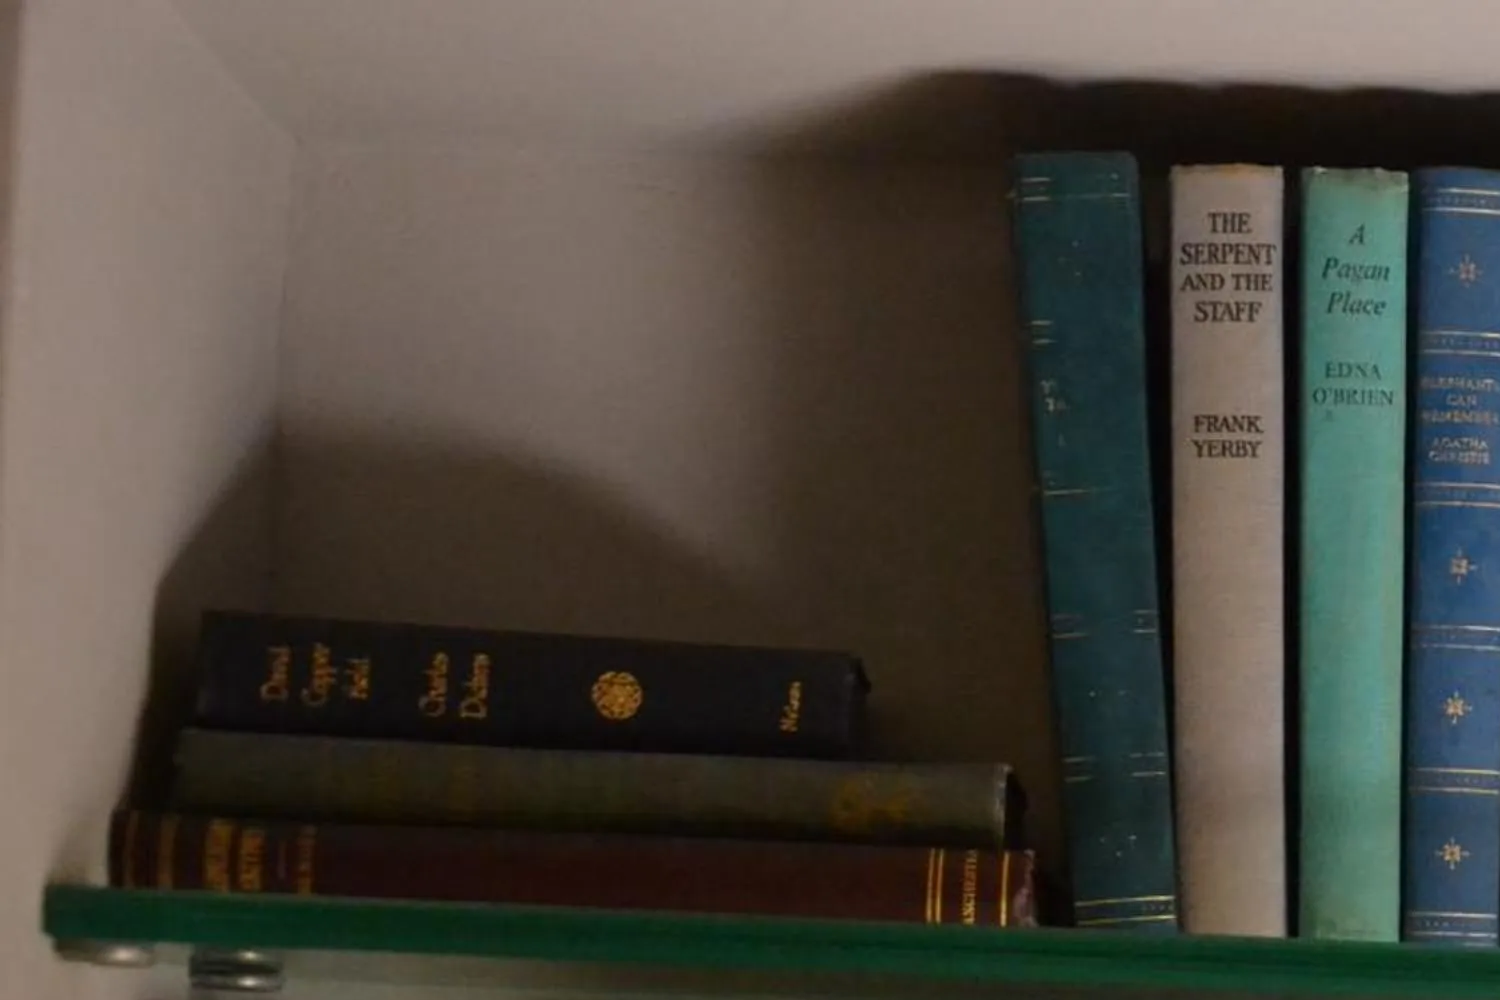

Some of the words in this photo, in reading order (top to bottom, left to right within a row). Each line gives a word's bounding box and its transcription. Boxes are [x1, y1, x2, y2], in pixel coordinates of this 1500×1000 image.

[1208, 212, 1252, 233] THE
[1348, 223, 1366, 246] A
[1179, 242, 1277, 266] SERPENT
[1322, 256, 1391, 283] Pagan
[1180, 273, 1225, 291] AND
[1231, 273, 1273, 291] THE
[1193, 301, 1263, 323] STAFF
[1326, 290, 1387, 316] Place
[1325, 361, 1381, 380] EDNA
[1312, 387, 1394, 406] O'BRIEN
[1446, 393, 1477, 407] CAN
[1193, 414, 1264, 434] FRANK
[1192, 439, 1262, 459] YERBY
[1432, 436, 1488, 450] AGATHA
